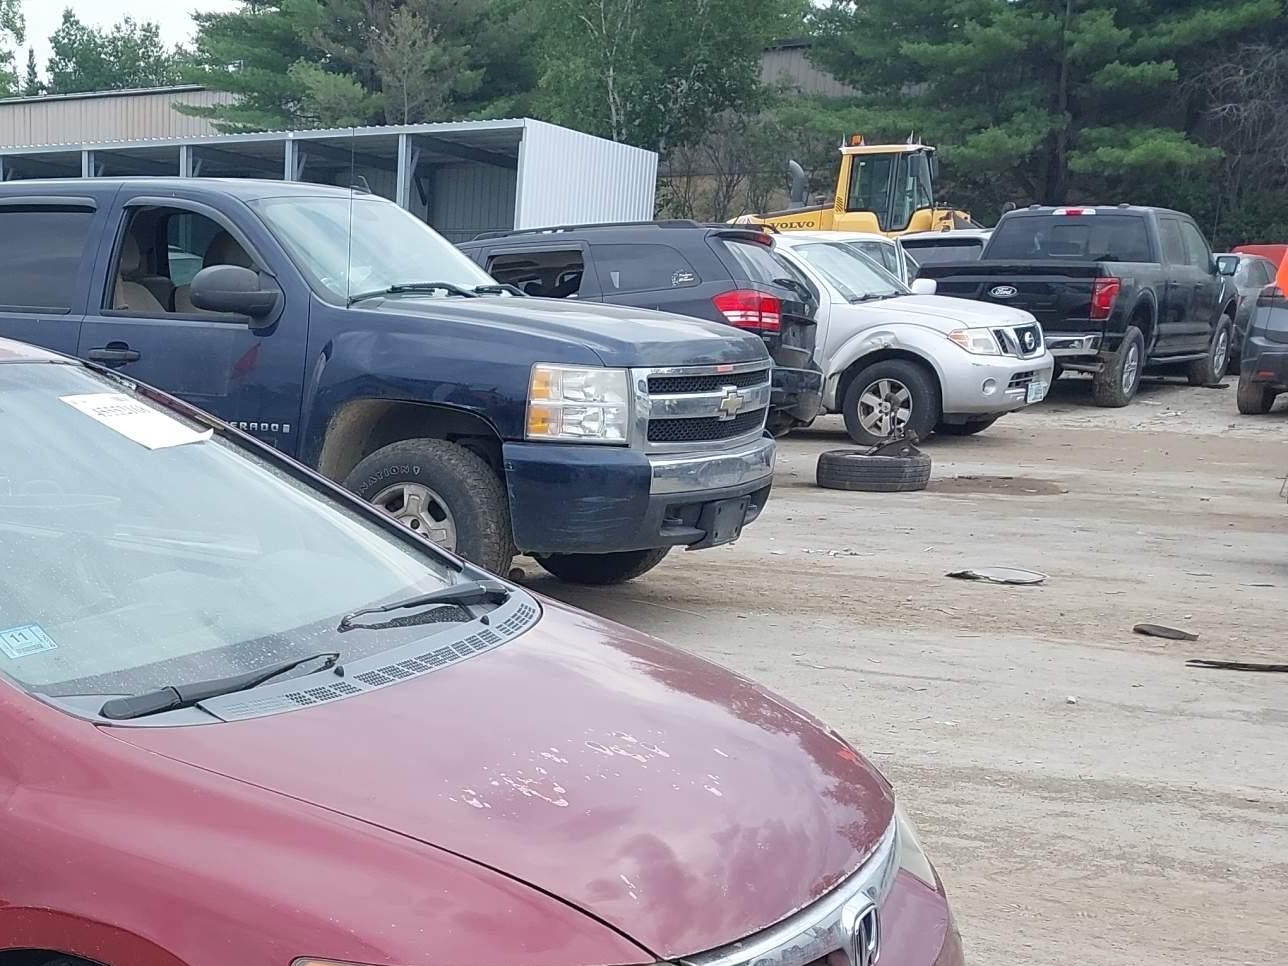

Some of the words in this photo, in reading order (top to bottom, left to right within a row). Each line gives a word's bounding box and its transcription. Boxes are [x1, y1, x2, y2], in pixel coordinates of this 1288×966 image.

[770, 221, 815, 229] VOLVO
[226, 421, 279, 432] ERADO
[10, 632, 29, 642] 11
